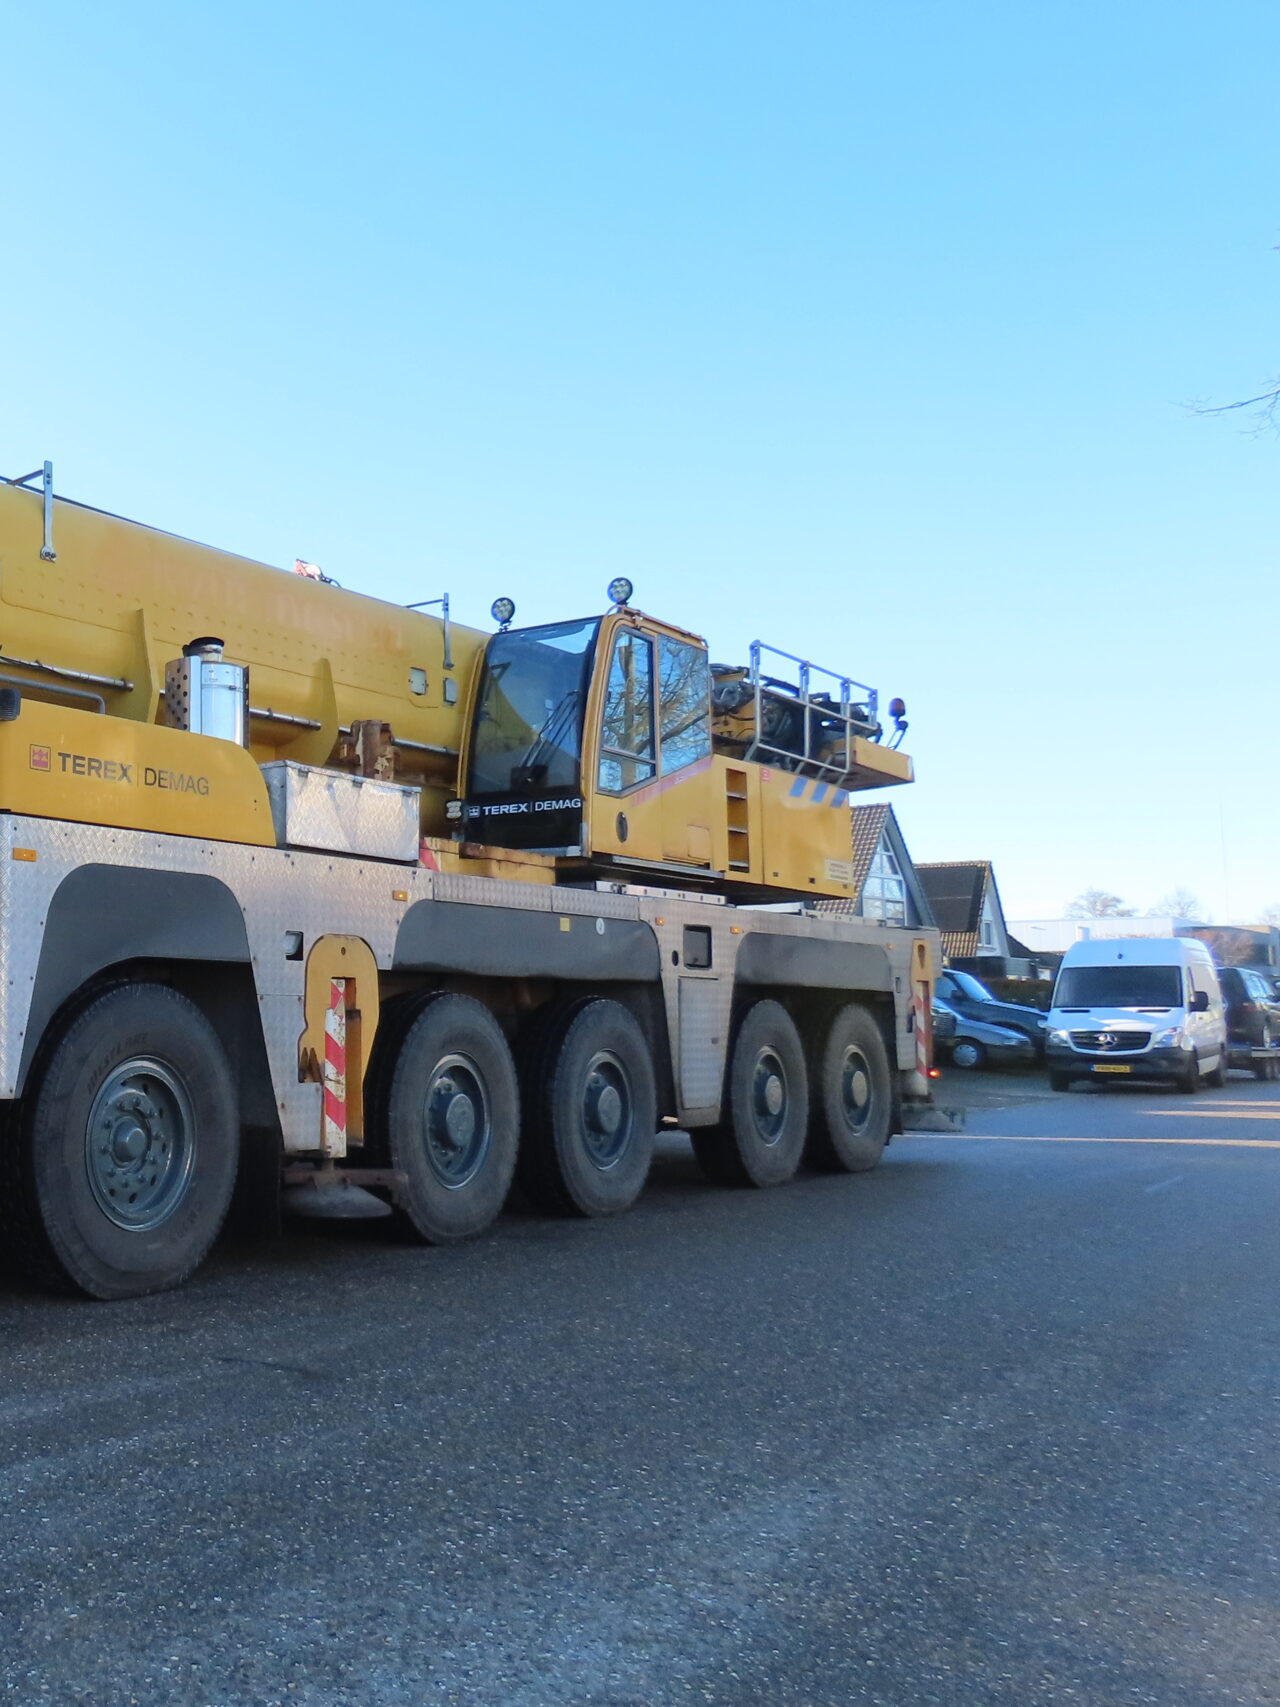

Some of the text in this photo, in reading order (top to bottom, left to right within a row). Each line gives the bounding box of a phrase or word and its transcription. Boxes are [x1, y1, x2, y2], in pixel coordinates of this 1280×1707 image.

[58, 752, 210, 796] TEREX DEMAG
[482, 798, 581, 816] TEREX DEMAG
